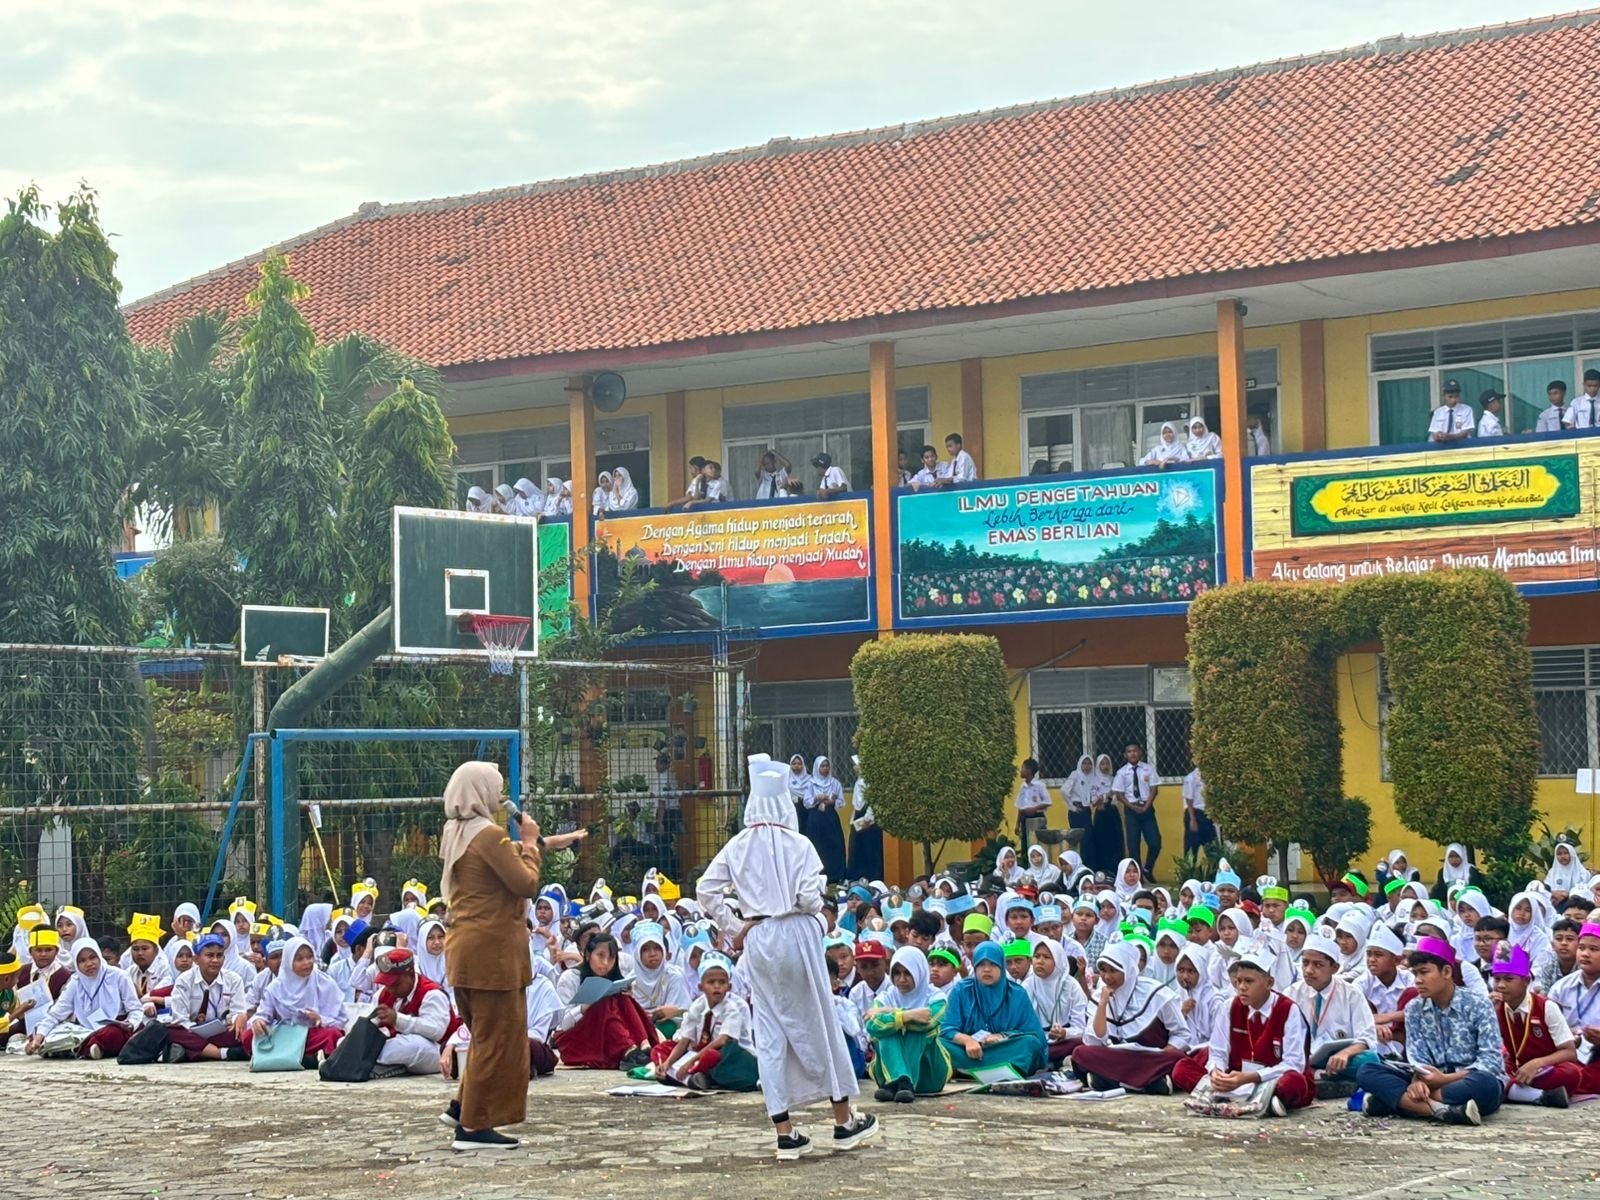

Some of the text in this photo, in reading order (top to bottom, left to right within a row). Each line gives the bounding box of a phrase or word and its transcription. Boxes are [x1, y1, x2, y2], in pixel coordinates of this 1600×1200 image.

[957, 481, 1160, 513] ILMU PENGETAHUAN
[1334, 506, 1376, 518] Belajar
[1378, 504, 1387, 513] di
[1389, 503, 1416, 514] waktu
[640, 510, 858, 542] Dengan Agama hidup menjadi terarah
[984, 508, 1026, 528] Lebih
[1029, 504, 1093, 524] Berharga
[662, 528, 856, 557] Dengan Seni hidup menjadi Indah
[987, 523, 1120, 545] EMAS BERLIAN
[673, 545, 867, 574] Dengan Ilmu hidup menjadi Mudah
[1272, 561, 1300, 582] Aku
[1302, 562, 1346, 583] datang
[1349, 559, 1384, 577] untuk
[1385, 555, 1435, 575] Belajar
[1493, 546, 1568, 572] Membawa
